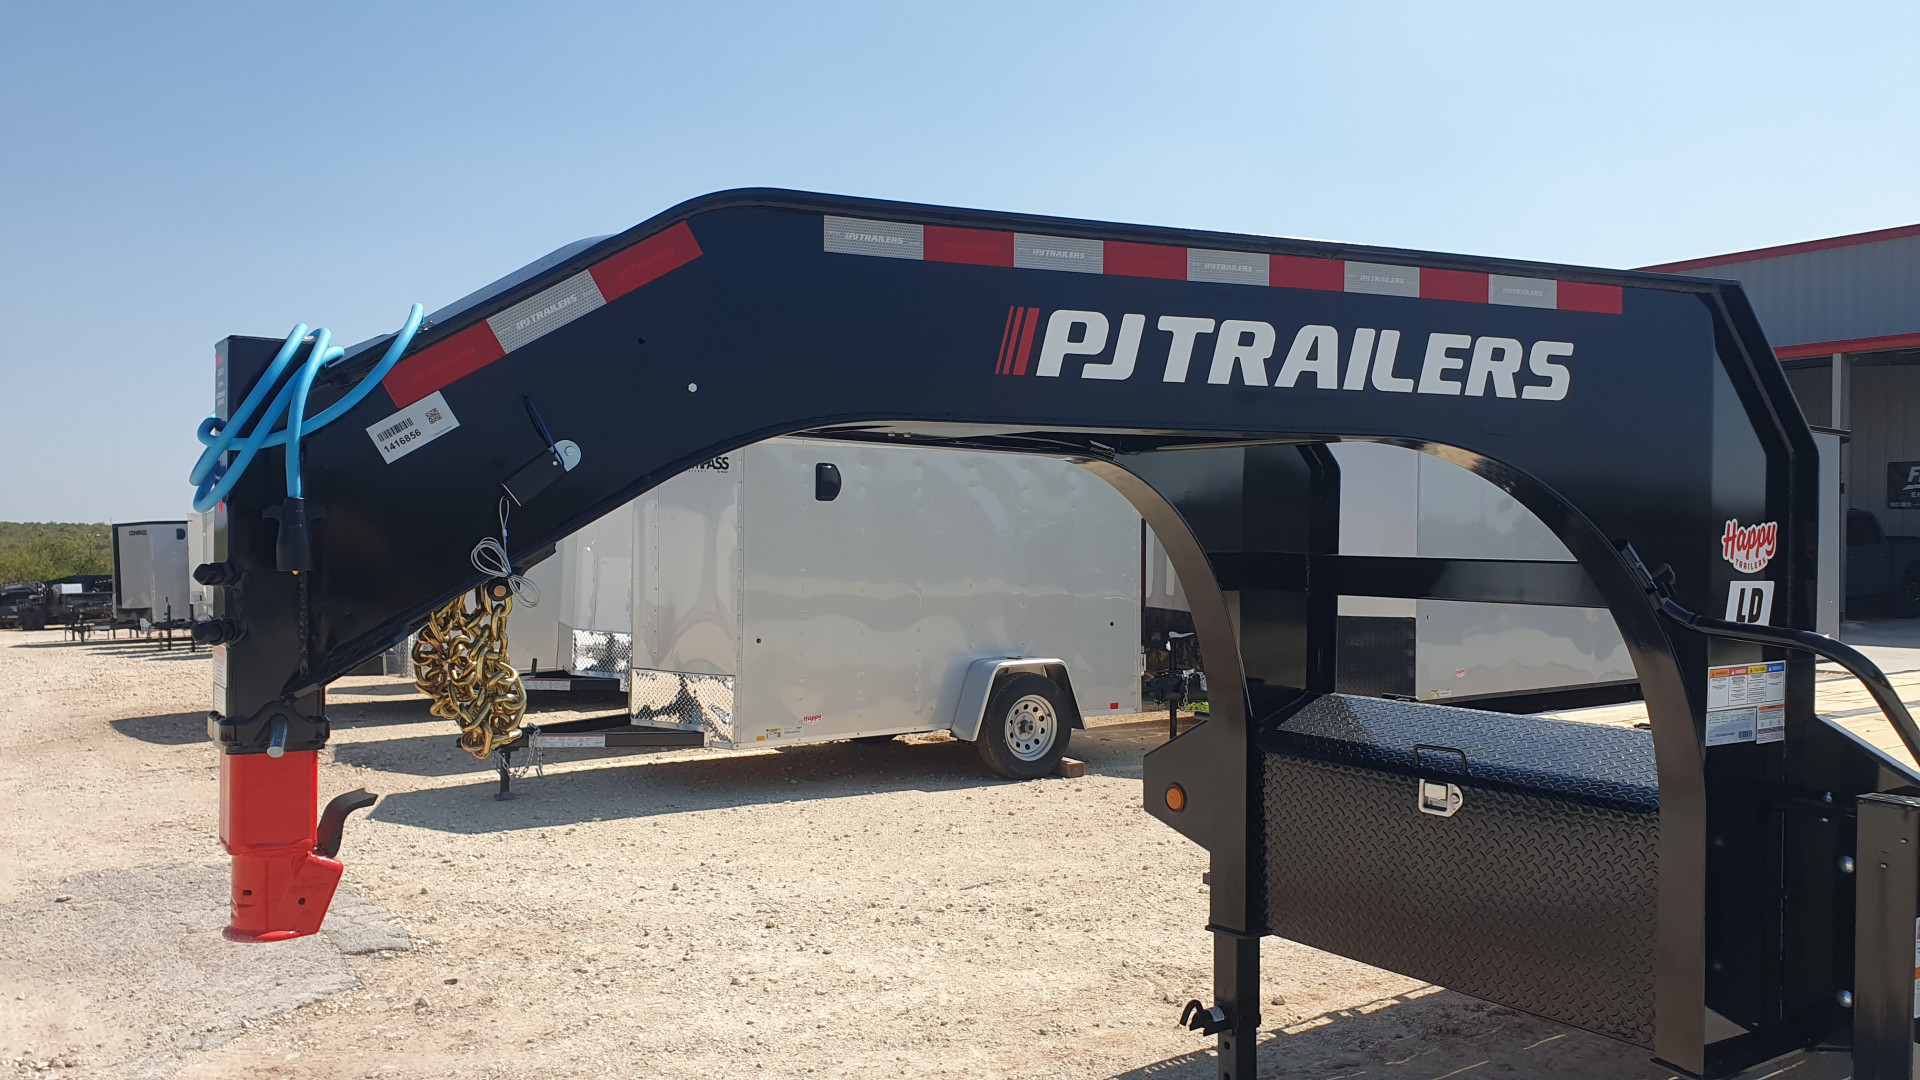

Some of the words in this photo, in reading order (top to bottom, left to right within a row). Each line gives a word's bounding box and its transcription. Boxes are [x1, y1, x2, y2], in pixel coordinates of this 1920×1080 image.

[1036, 309, 1146, 381] PJ
[1157, 315, 1575, 401] TRAILERS
[383, 429, 422, 453] 1416856
[1723, 521, 1776, 561] Happy
[1736, 557, 1767, 570] TRAILERS
[1736, 587, 1764, 624] LD
